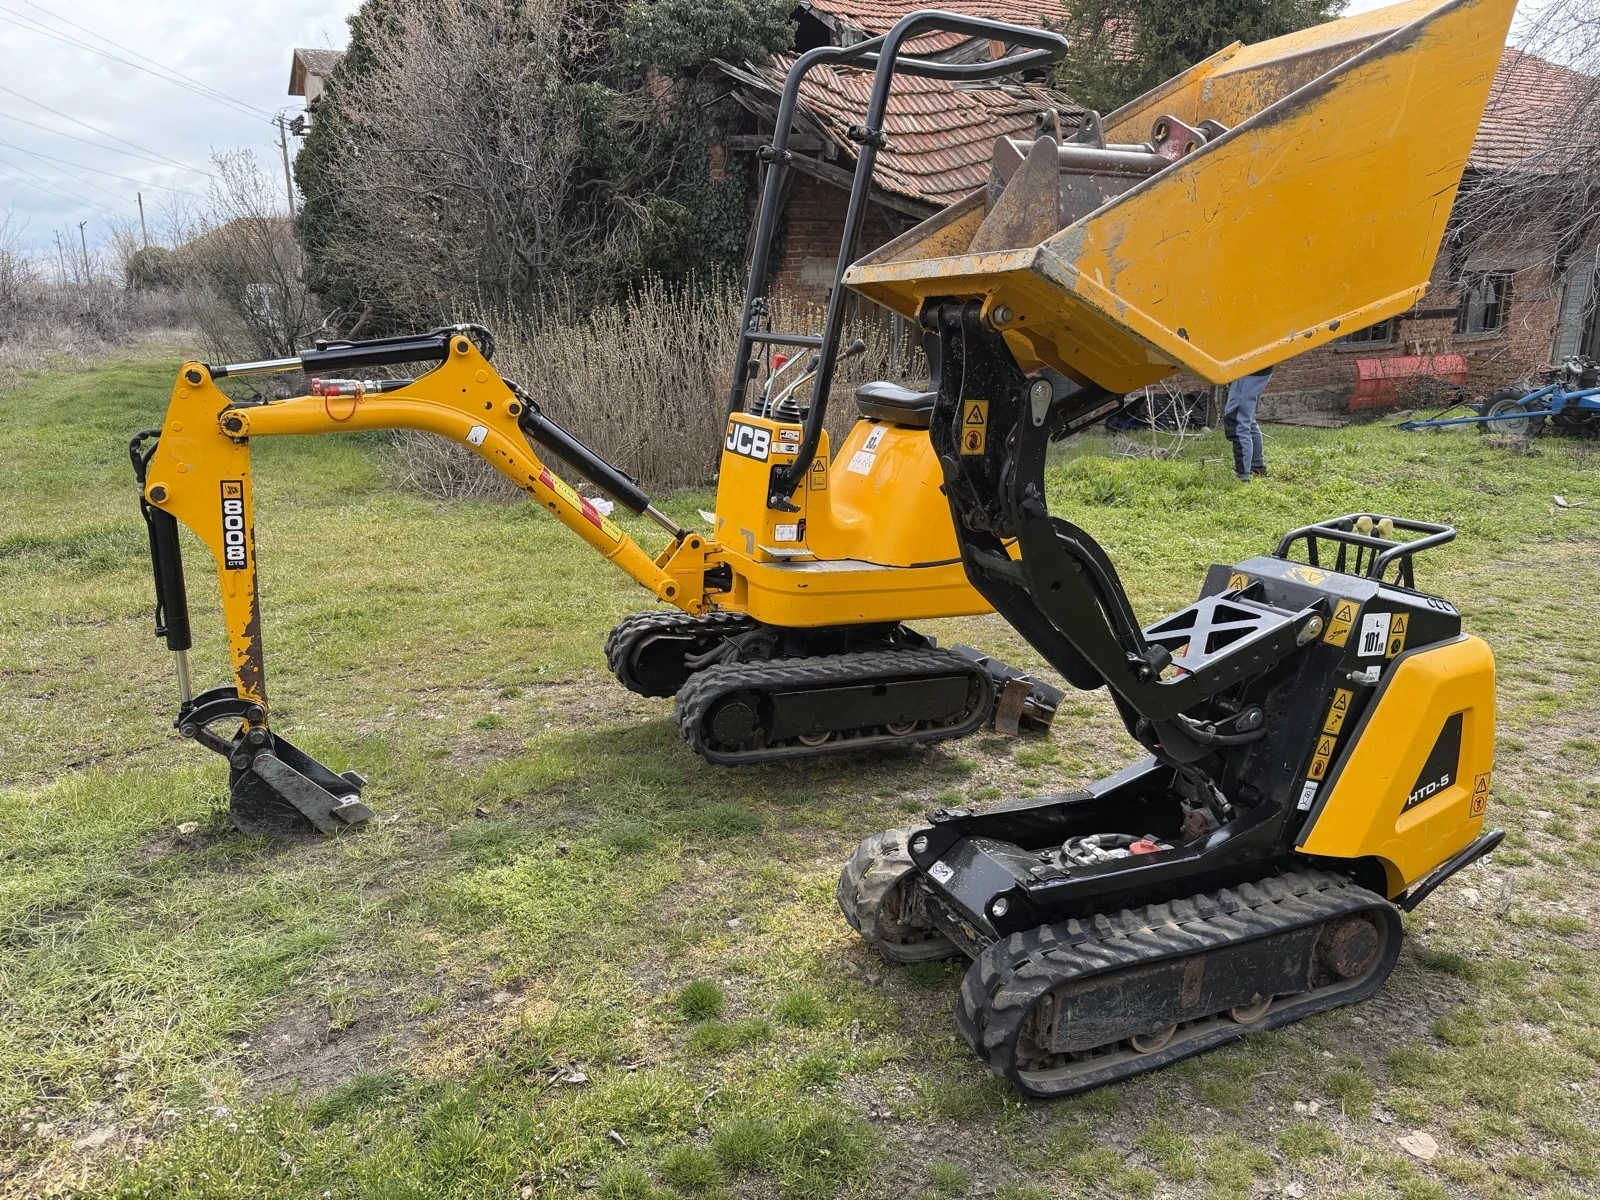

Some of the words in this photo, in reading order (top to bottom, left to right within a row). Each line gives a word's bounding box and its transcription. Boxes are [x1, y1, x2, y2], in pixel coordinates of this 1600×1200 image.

[727, 424, 770, 459] JCB
[224, 500, 245, 560] 8008
[1364, 632, 1380, 652] 101
[1408, 774, 1449, 805] HTD-5
